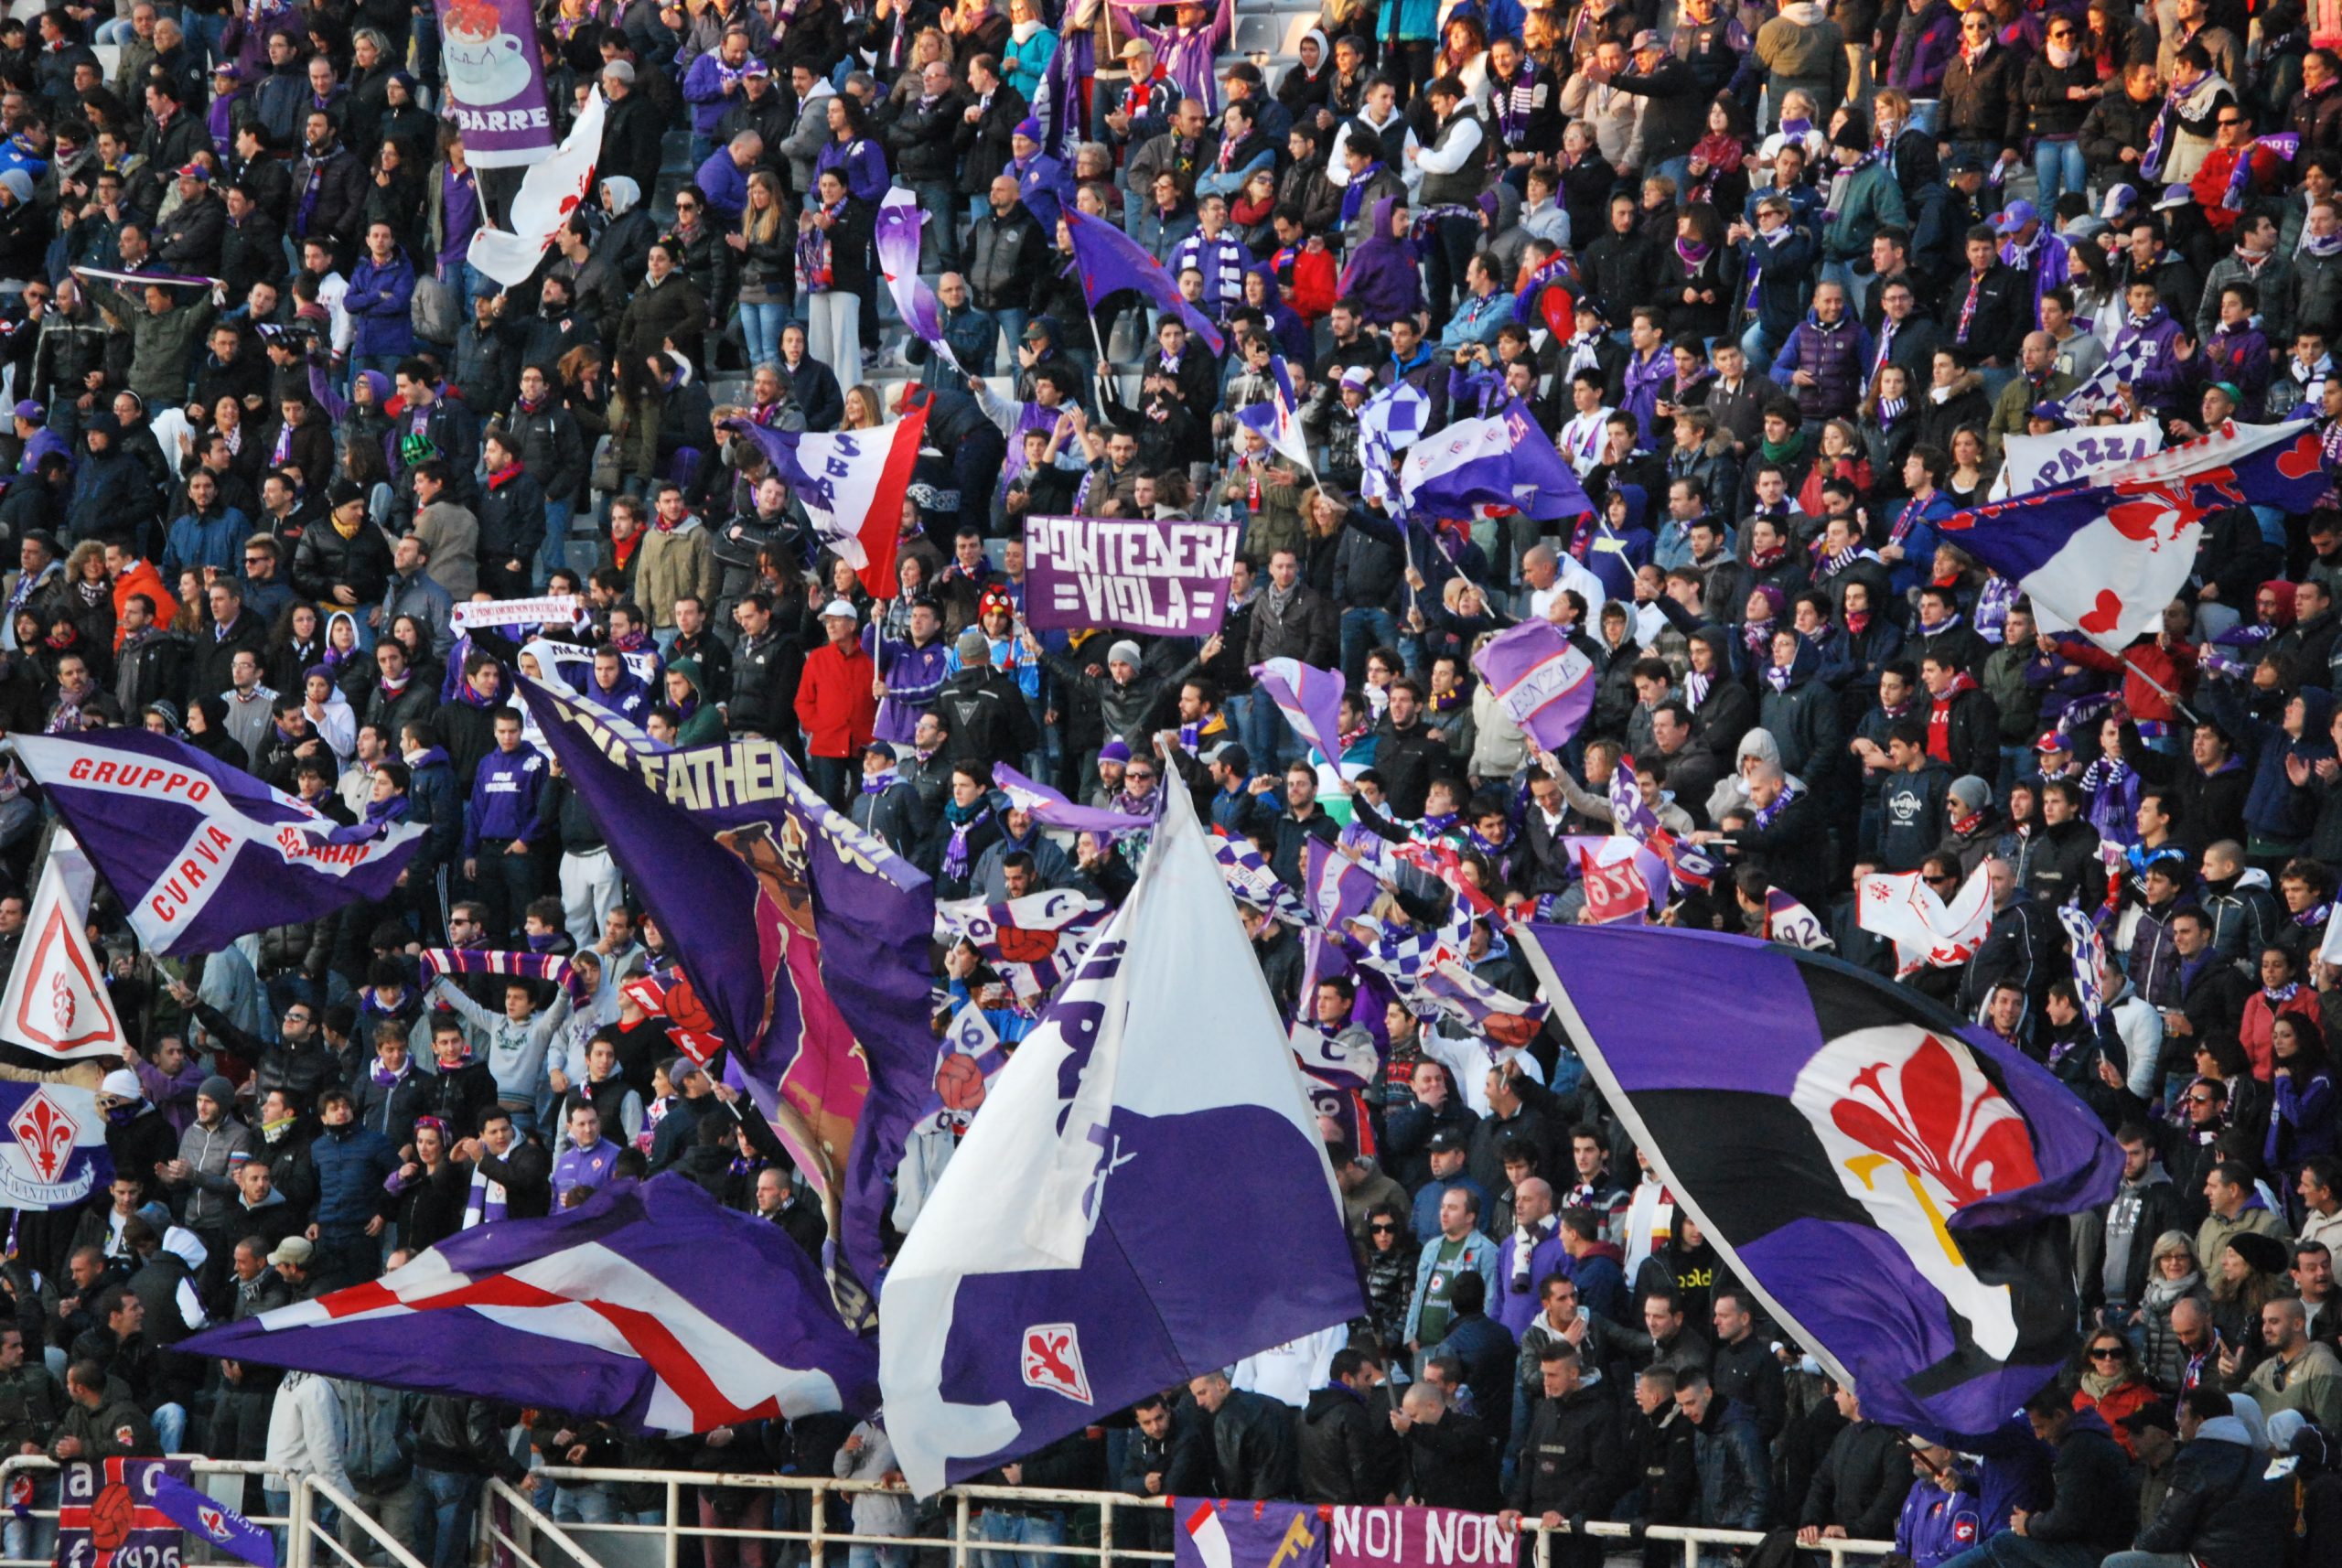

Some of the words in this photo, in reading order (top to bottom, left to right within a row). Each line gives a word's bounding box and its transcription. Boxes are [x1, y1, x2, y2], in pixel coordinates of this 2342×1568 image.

[457, 106, 550, 132] BARRE
[1026, 515, 1239, 579] PONTEDERA
[69, 757, 211, 802] GRUPPO
[637, 741, 786, 811] FATHE
[151, 824, 232, 922] CURVA
[1333, 1505, 1403, 1564] NOI
[1425, 1509, 1515, 1565] NON
